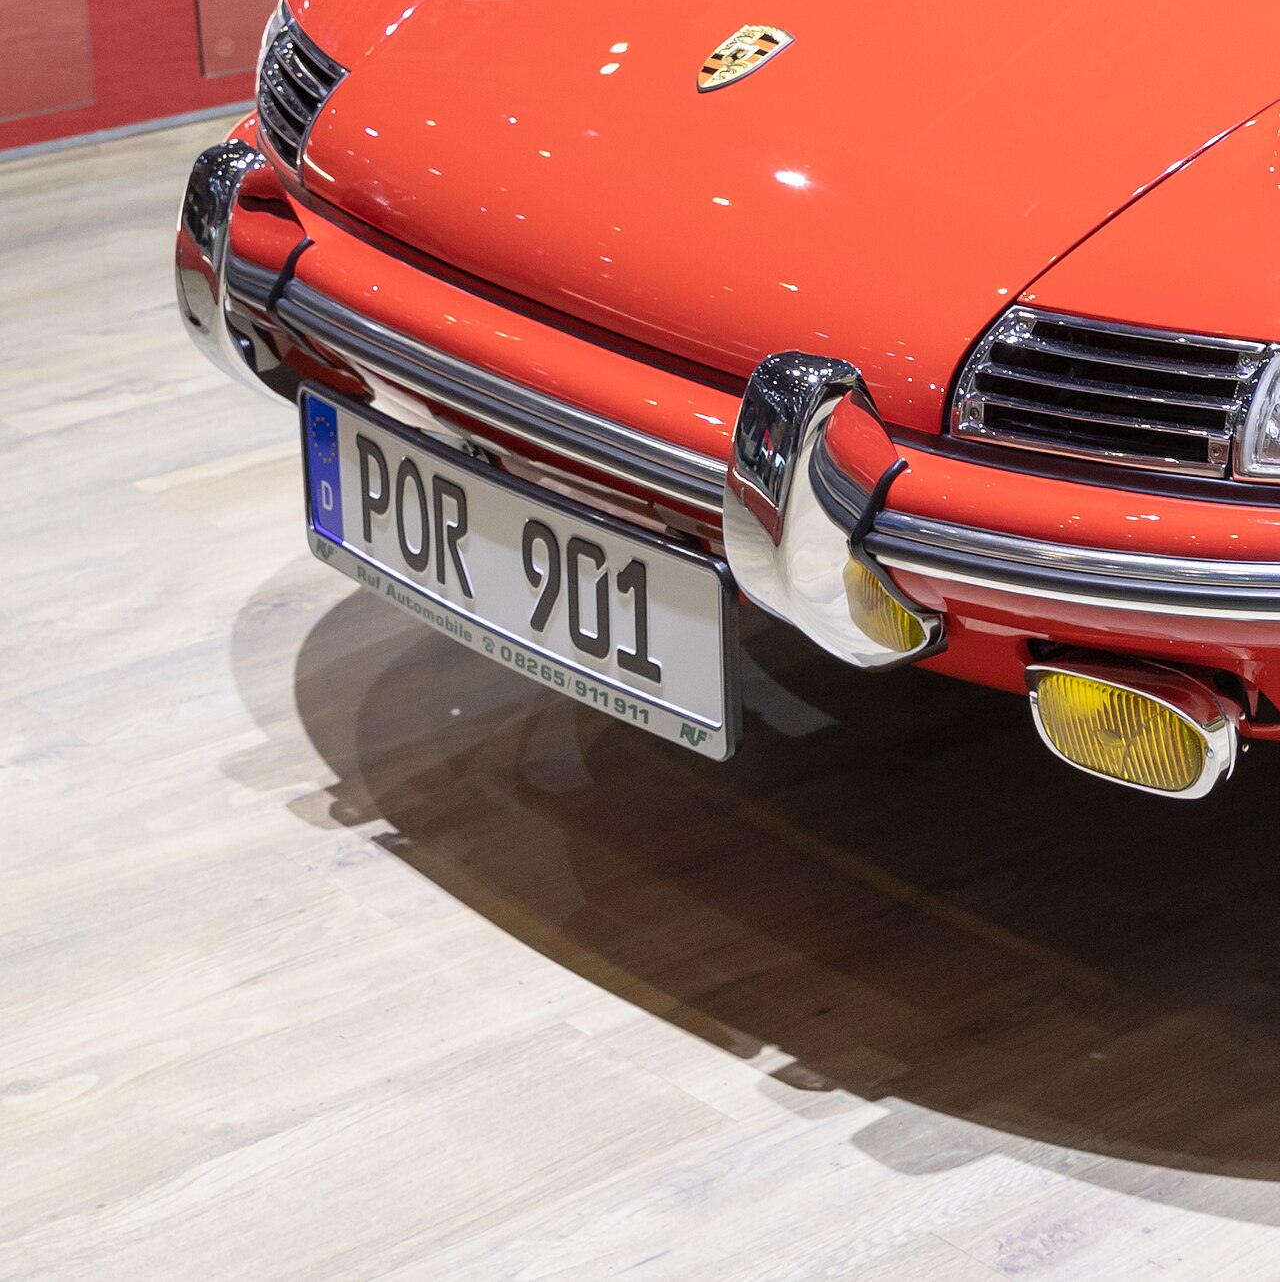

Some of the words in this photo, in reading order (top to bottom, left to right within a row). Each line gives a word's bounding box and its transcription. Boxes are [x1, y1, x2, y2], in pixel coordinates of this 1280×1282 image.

[321, 480, 333, 511] D
[356, 432, 475, 600] POR
[522, 519, 662, 685] 901
[357, 564, 381, 591] Ruf
[386, 583, 473, 643] Automobile
